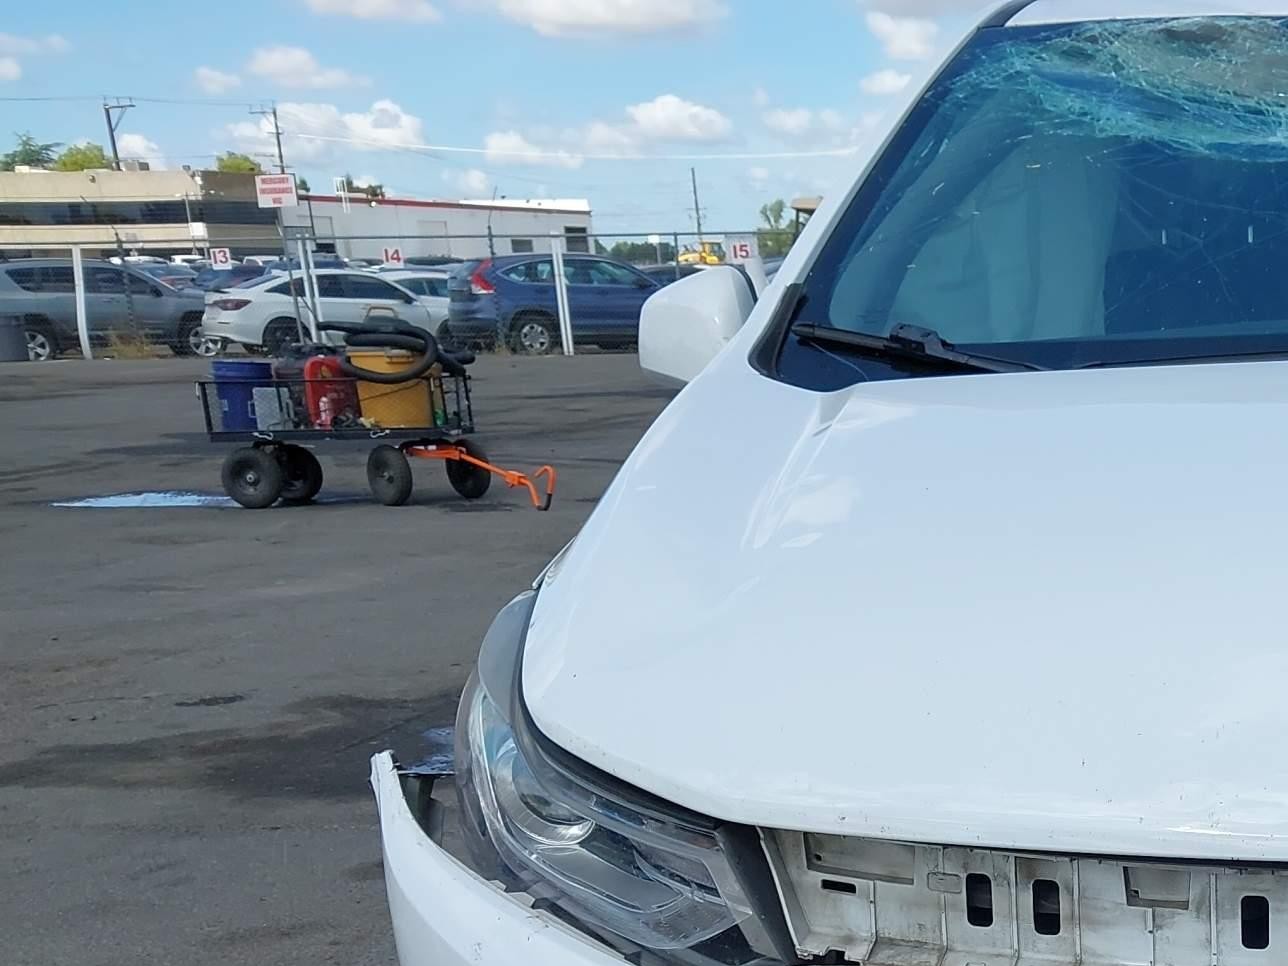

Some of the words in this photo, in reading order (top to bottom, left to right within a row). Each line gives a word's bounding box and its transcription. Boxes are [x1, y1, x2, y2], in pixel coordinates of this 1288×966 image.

[211, 249, 229, 264] 13
[383, 248, 401, 263] 14
[732, 244, 749, 259] 15
